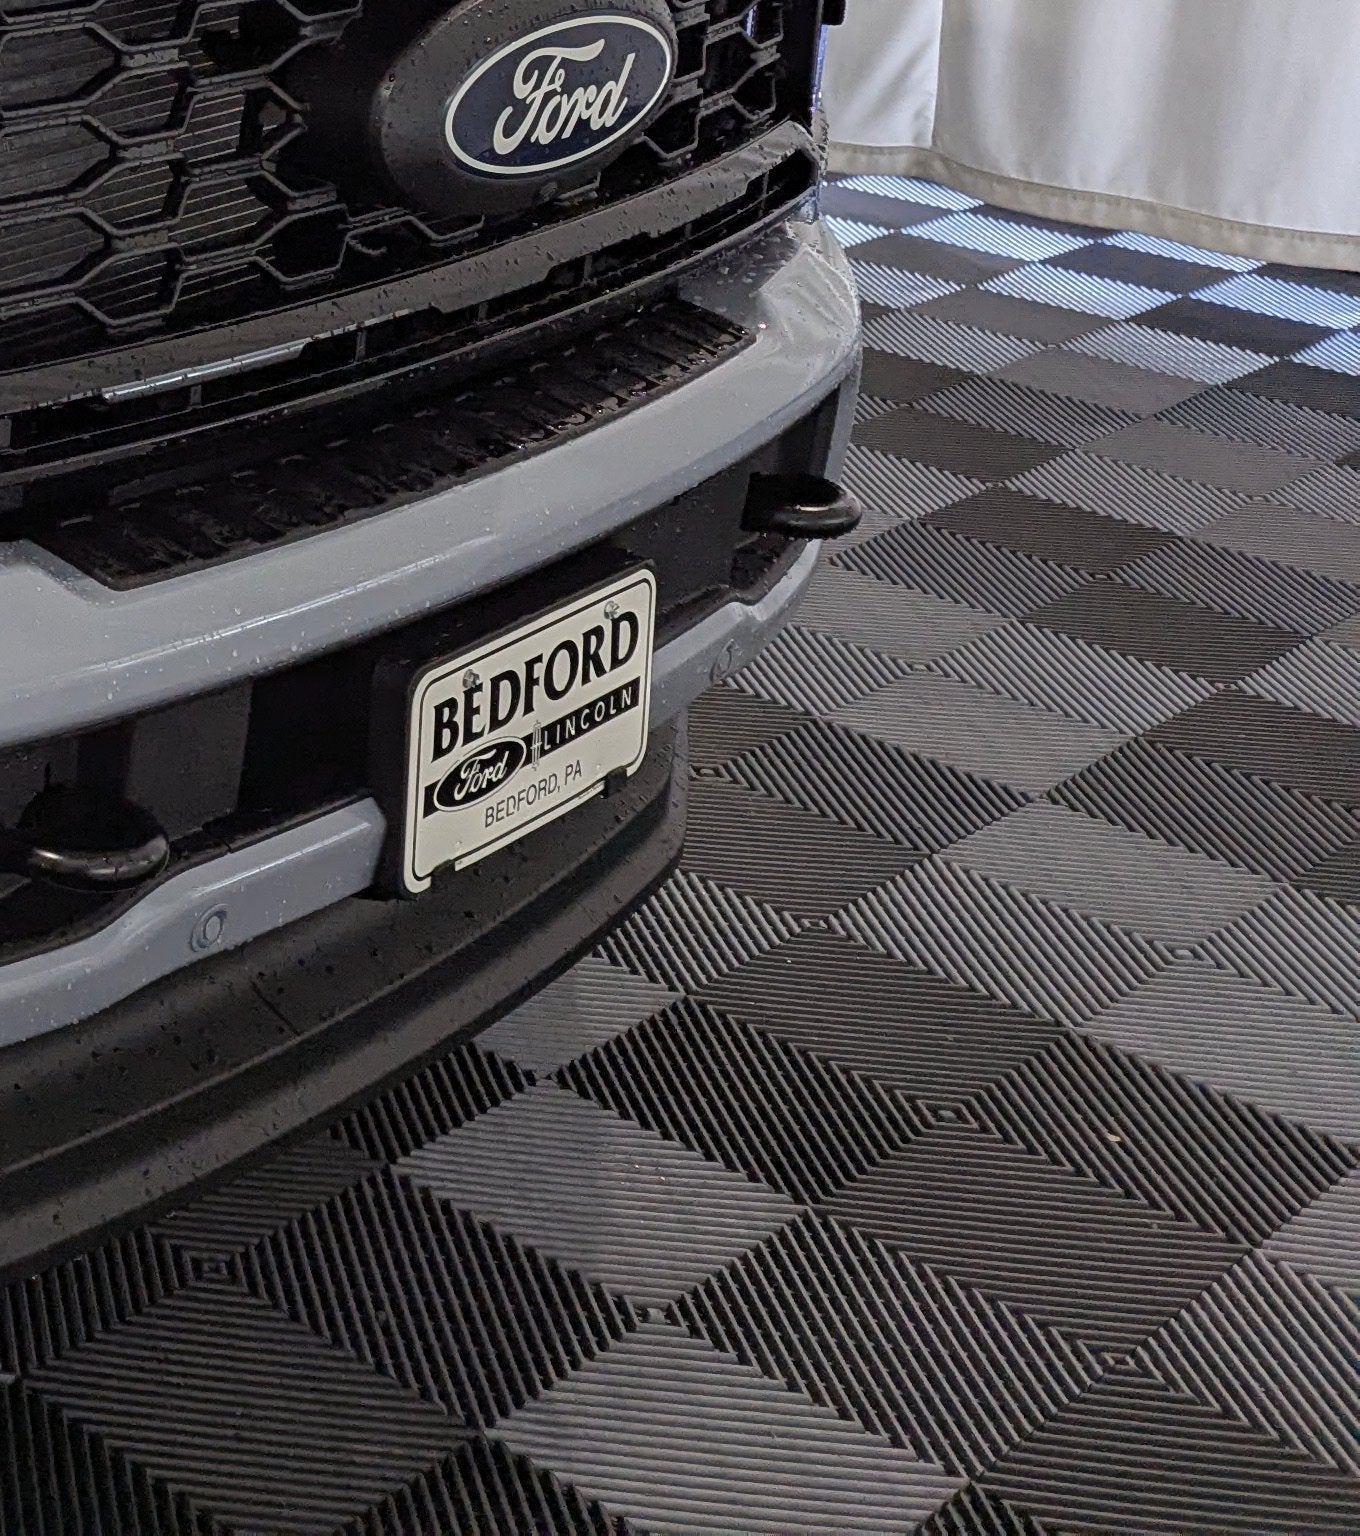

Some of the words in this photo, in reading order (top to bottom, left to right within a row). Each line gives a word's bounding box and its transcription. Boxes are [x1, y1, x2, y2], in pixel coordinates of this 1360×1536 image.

[492, 38, 637, 156] Ford
[430, 610, 640, 764] BEDFORD
[542, 686, 634, 752] LINCOLN
[453, 750, 510, 802] Ford
[483, 771, 562, 828] BEDFORD,
[562, 758, 583, 788] PA
